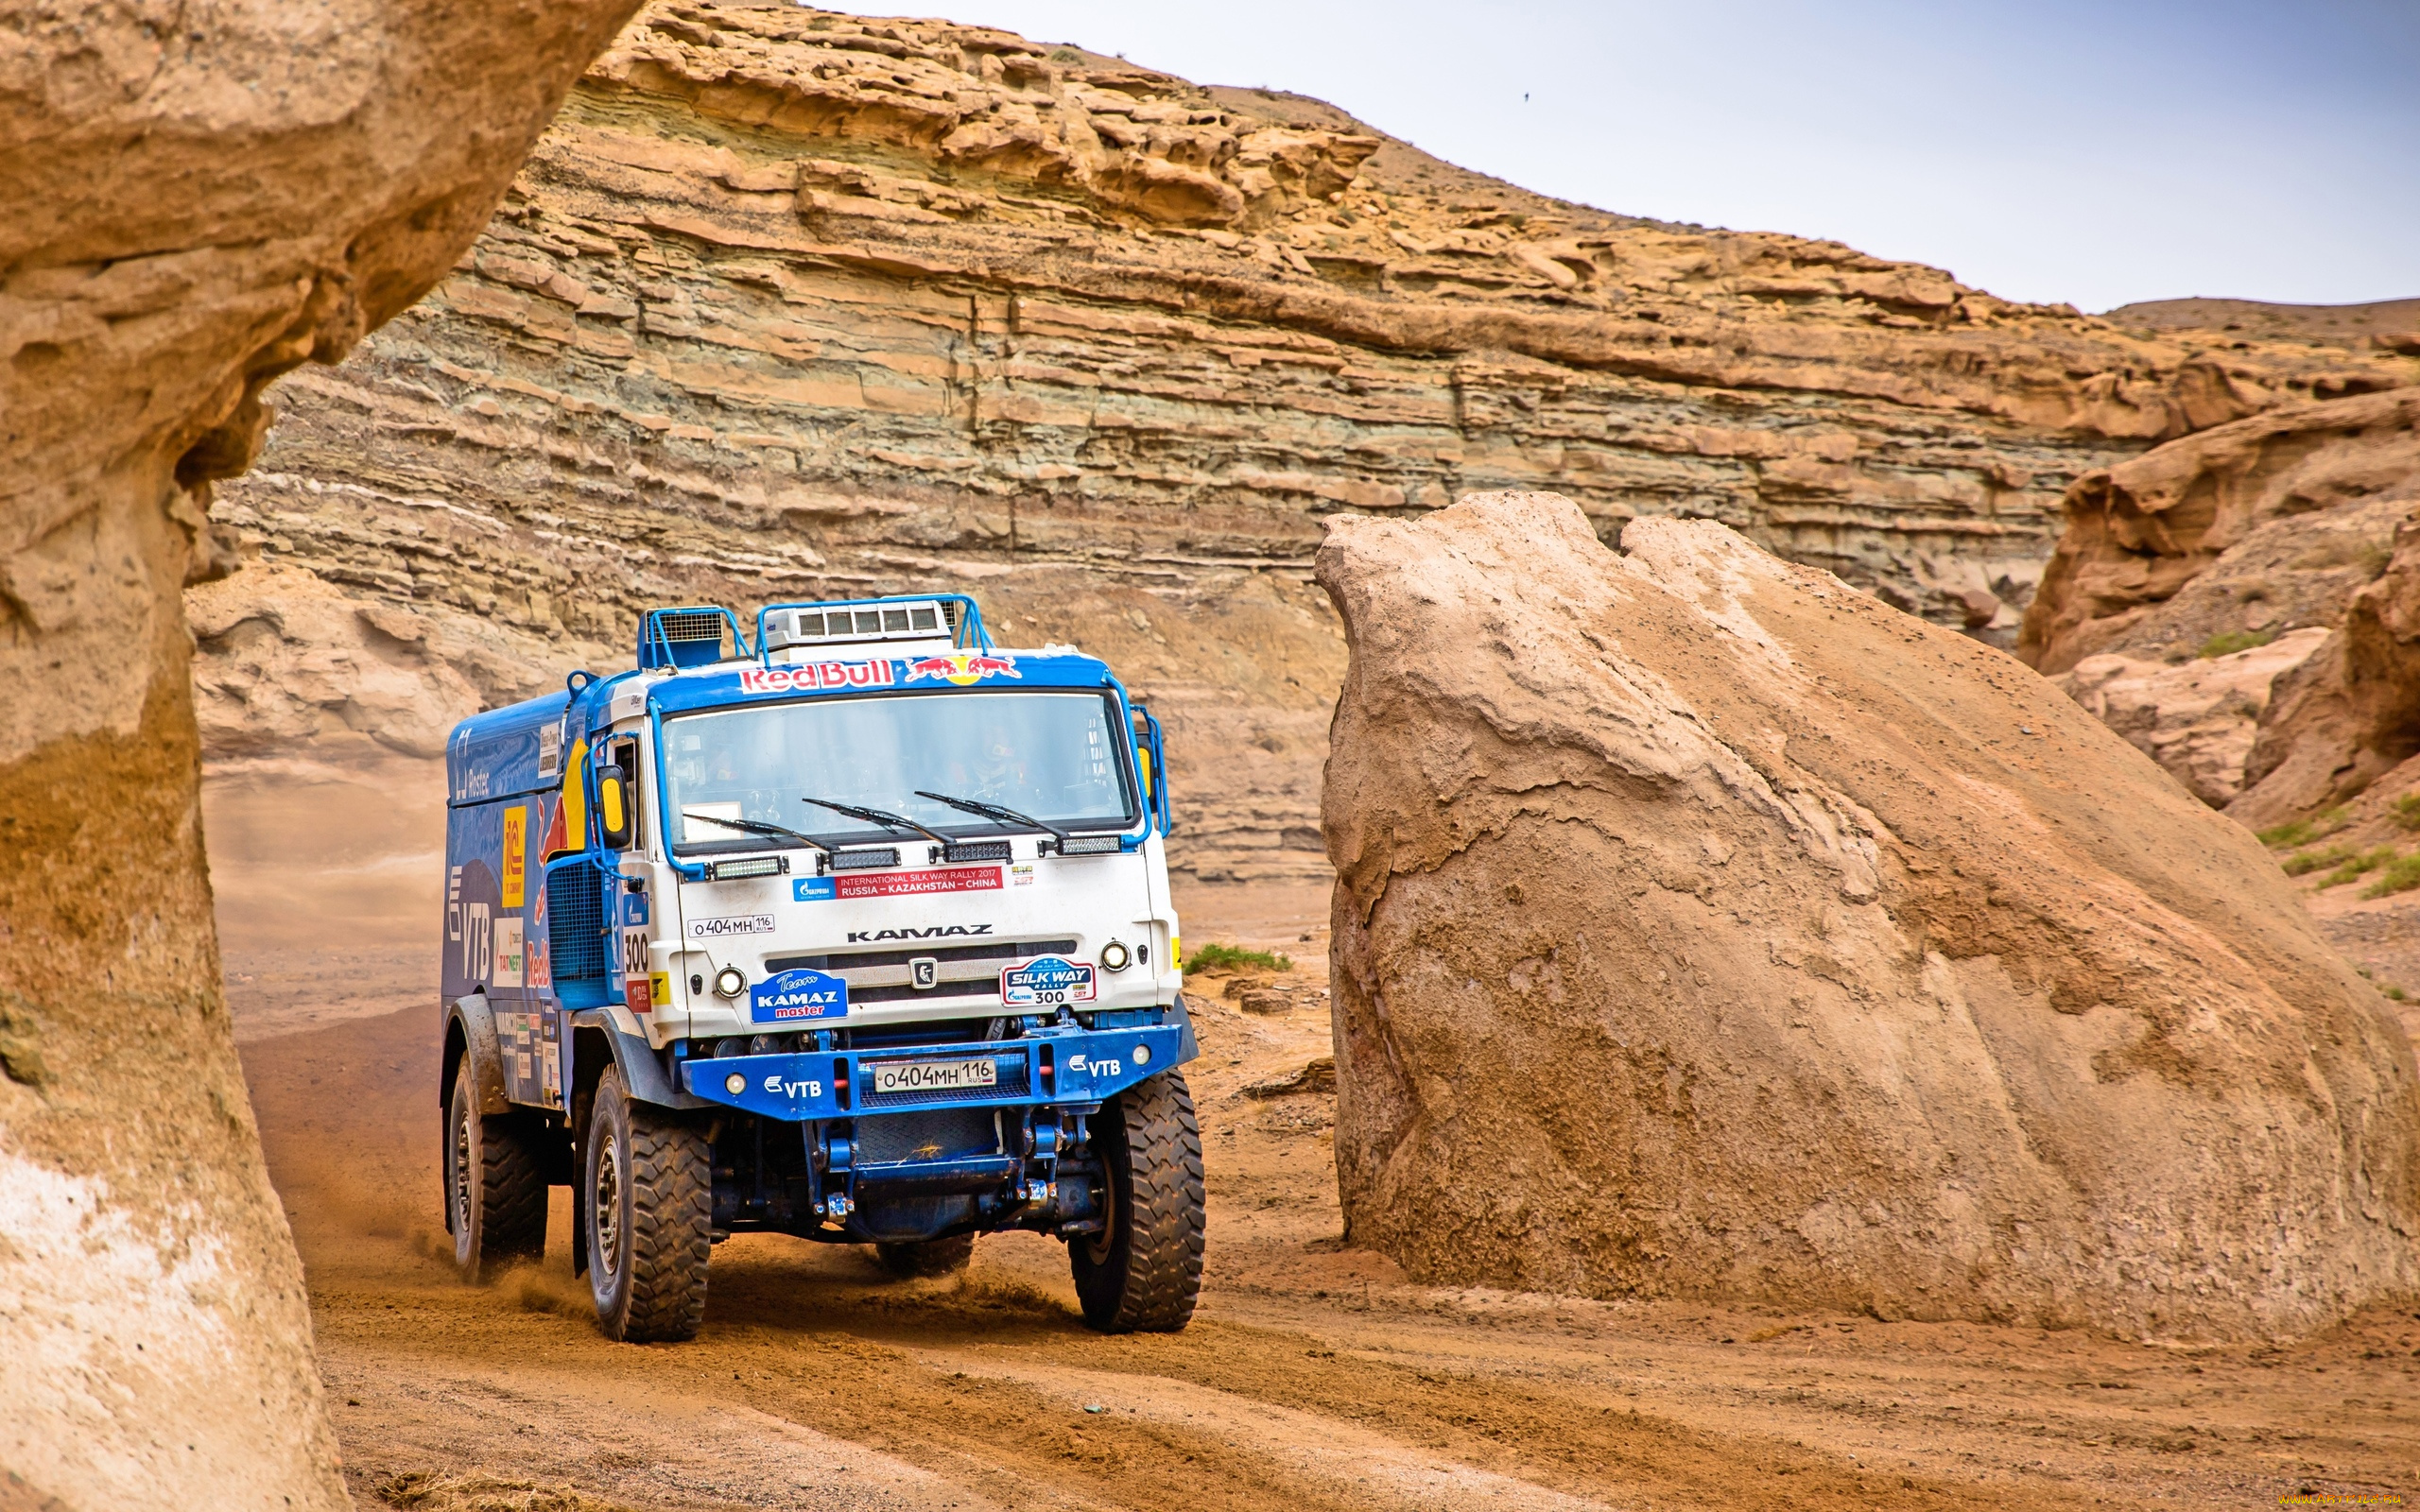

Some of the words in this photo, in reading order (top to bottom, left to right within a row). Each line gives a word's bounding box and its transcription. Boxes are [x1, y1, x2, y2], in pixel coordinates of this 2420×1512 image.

[840, 874, 908, 886] INTERNATIONAL
[910, 873, 928, 882] SILK
[929, 871, 948, 881] WAY
[950, 870, 977, 880] RALLY
[978, 869, 996, 878] 2017
[841, 885, 878, 897] RUSSIA
[888, 881, 957, 894] KAZAKHSTAN
[965, 878, 997, 888] CHINA
[755, 916, 770, 927] 116
[463, 902, 490, 981] VTB
[847, 923, 994, 943] KAMAZ
[625, 932, 648, 973] 300
[499, 954, 522, 972] TATNEFT
[776, 973, 819, 992] Team
[1011, 971, 1049, 985] SILK
[1052, 970, 1086, 982] WAY
[757, 991, 838, 1007] KAMAZ
[1035, 991, 1064, 1005] 300
[775, 1005, 825, 1019] master
[962, 1061, 991, 1078] 116
[1088, 1059, 1121, 1077] VTB
[784, 1080, 822, 1099] VTB
